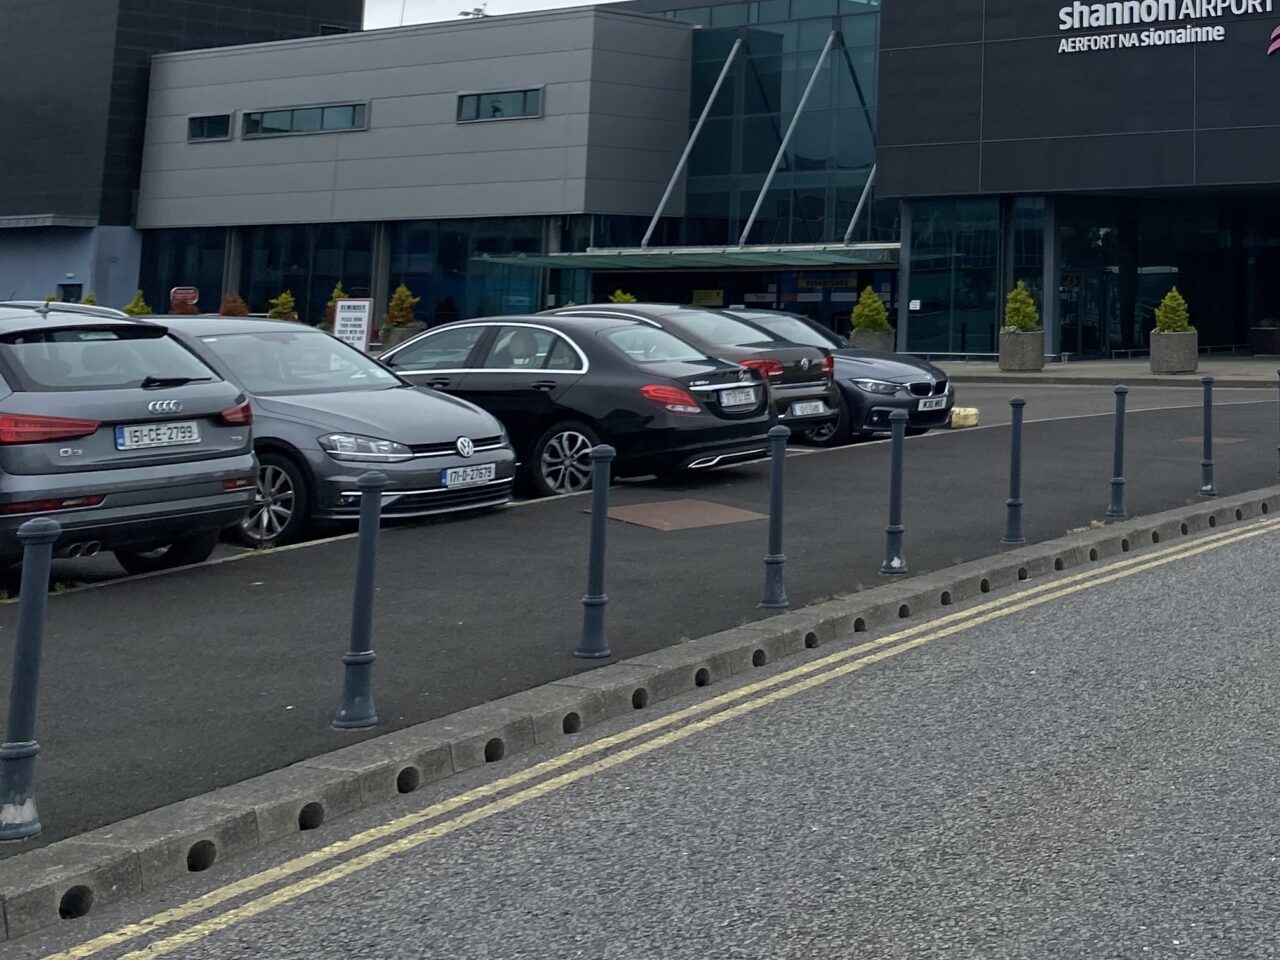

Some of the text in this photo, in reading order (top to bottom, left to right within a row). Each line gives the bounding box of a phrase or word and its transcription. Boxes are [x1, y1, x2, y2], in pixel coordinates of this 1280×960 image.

[1058, 25, 1225, 54] AERFORT NA sionainne
[130, 425, 193, 444] 151-CE-2799
